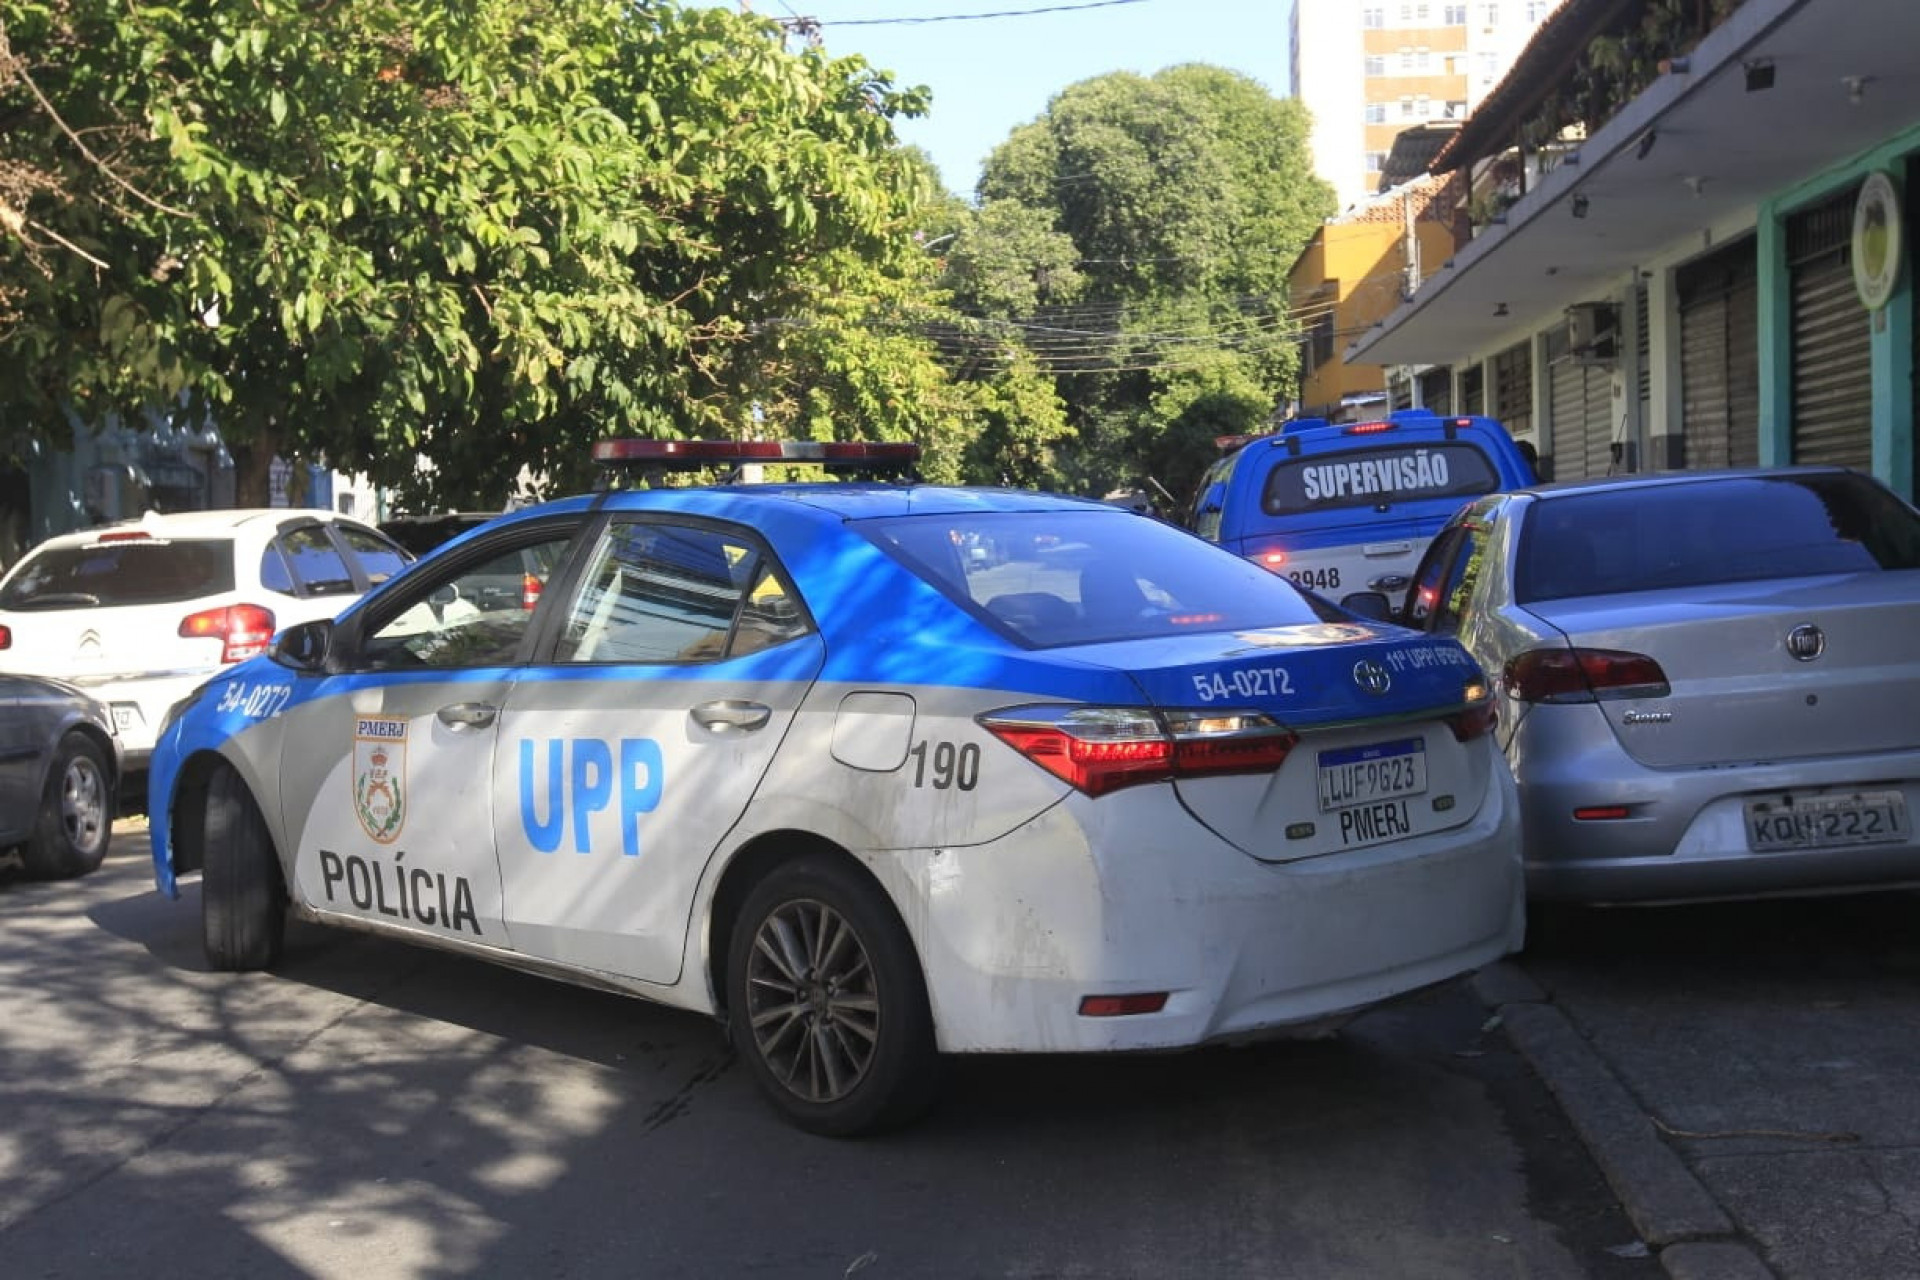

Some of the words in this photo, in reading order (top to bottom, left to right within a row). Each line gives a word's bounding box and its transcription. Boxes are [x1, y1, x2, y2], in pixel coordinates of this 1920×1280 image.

[1302, 449, 1450, 501] SUPERVISÃO
[217, 681, 291, 718] 54-0272
[1191, 667, 1295, 702] 54-0272
[358, 721, 404, 737] PMERJ
[911, 739, 981, 792] 190
[1329, 756, 1415, 802] LUF9G23
[519, 737, 665, 857] UPP
[1340, 800, 1411, 845] PMERJ
[319, 850, 483, 936] POLÍCIA
